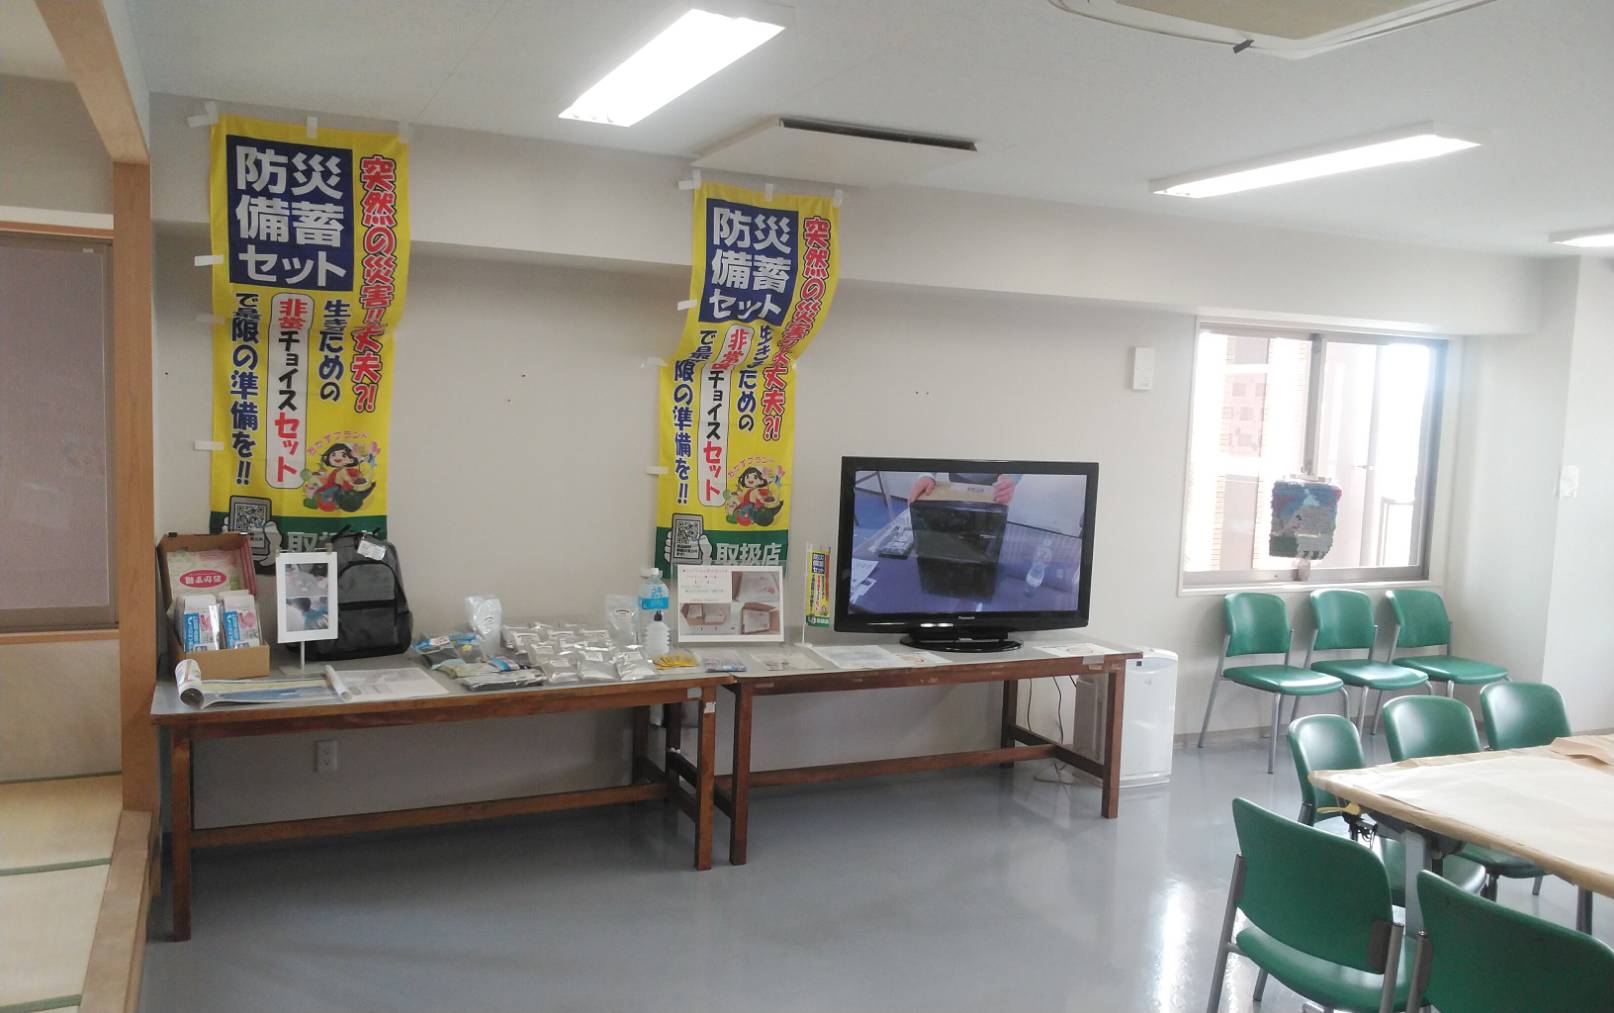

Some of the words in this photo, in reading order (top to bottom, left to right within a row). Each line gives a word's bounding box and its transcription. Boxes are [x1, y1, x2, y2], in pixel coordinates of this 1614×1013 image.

[236, 145, 343, 199] 防災
[236, 194, 344, 247] 備蓄
[713, 207, 791, 254] 防災
[238, 244, 346, 287] セット
[351, 155, 398, 414] 突然の災害!!丈夫?!
[711, 248, 791, 293] 備蓄
[709, 289, 782, 320] セット
[318, 299, 351, 402] 生きための
[737, 325, 773, 431] 生きための
[716, 542, 782, 566] 取扱店
